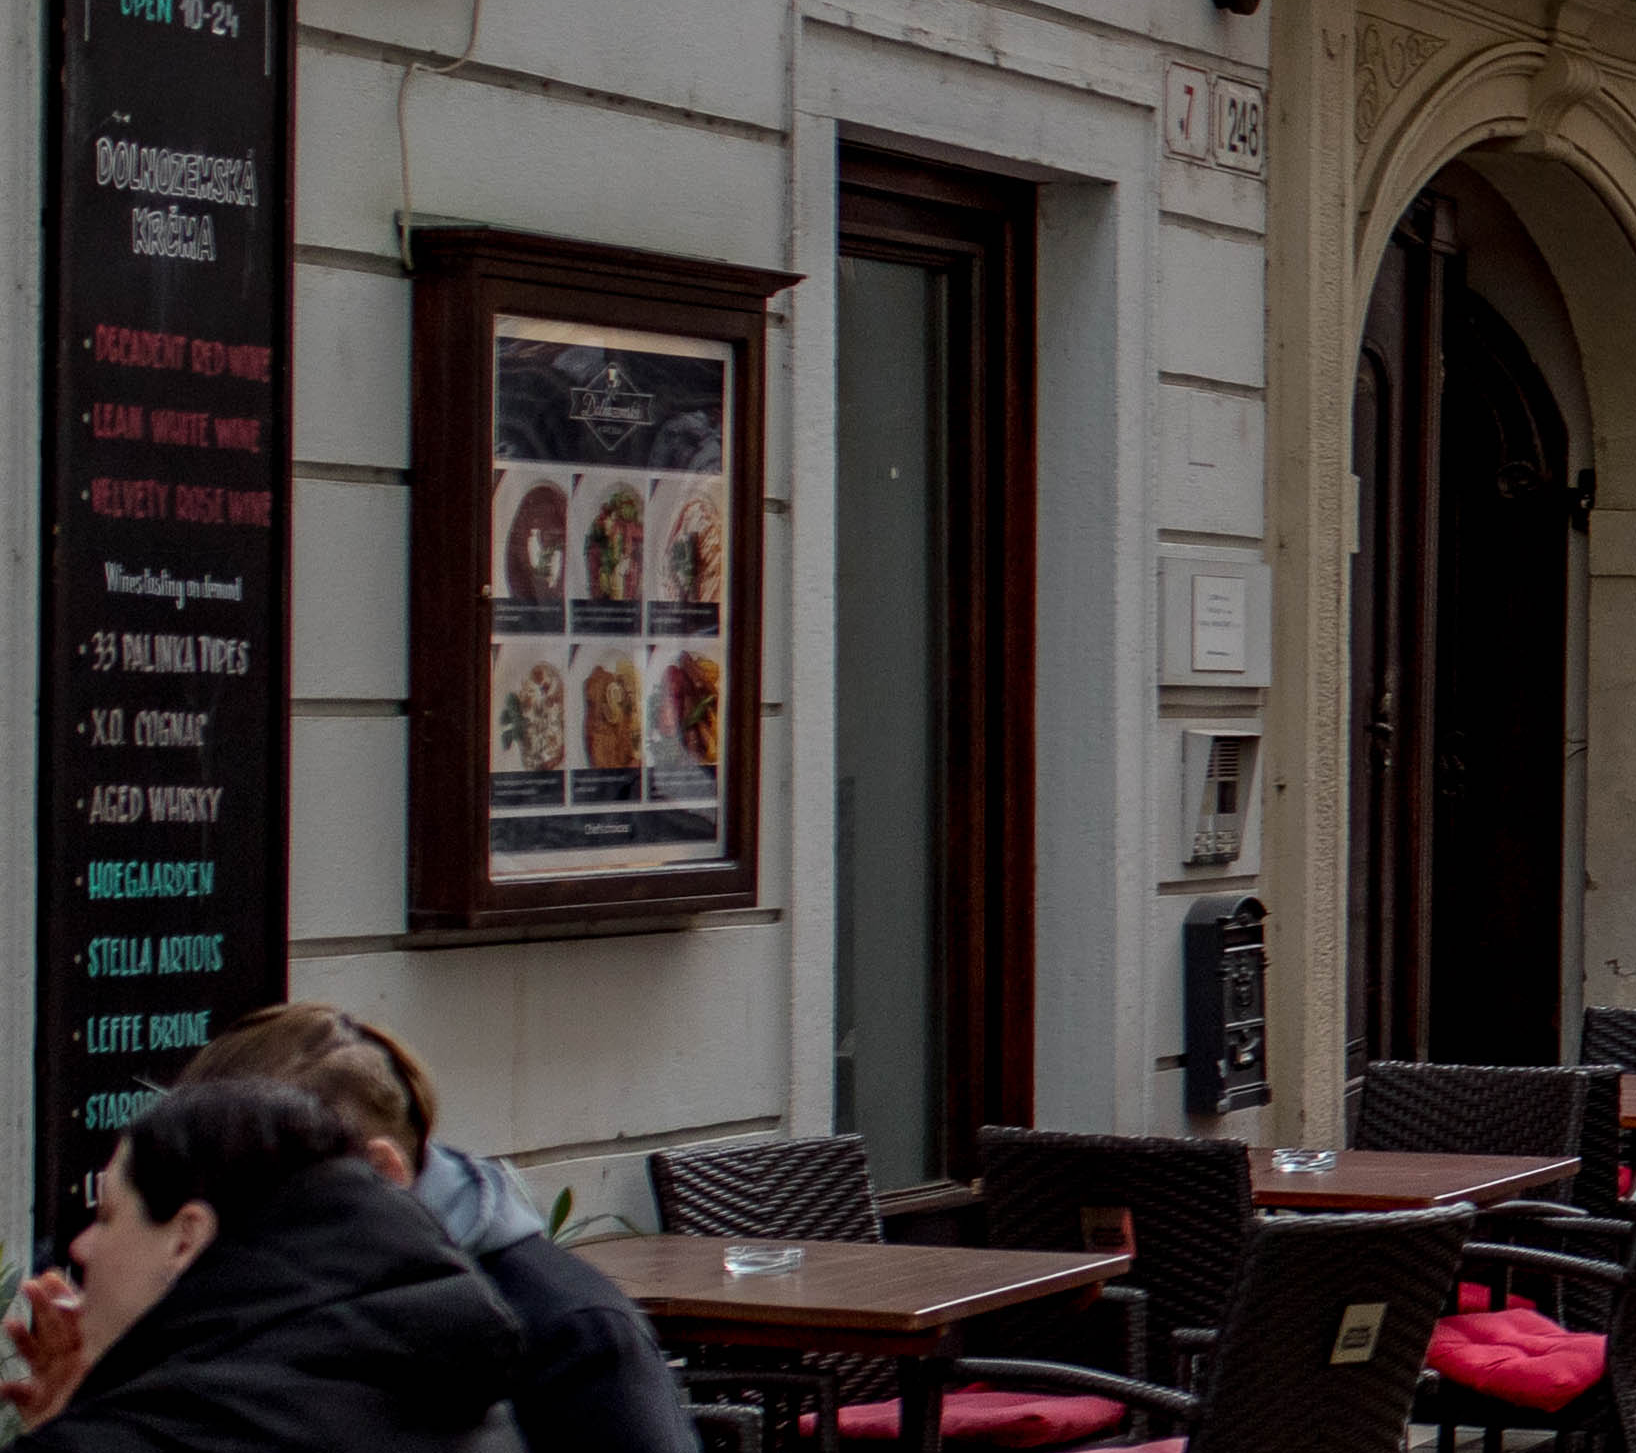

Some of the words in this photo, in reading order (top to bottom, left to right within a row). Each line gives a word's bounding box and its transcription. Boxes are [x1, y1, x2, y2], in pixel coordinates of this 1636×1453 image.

[92, 631, 117, 671] 33
[197, 635, 249, 675] TYPES
[89, 784, 144, 824] AGED
[148, 785, 224, 824] WHISKY
[88, 860, 215, 900] HOEGAARDEN
[88, 935, 152, 978] STELLA
[158, 932, 223, 975] ARTOIS
[86, 1014, 144, 1054] LEFFE
[150, 1009, 212, 1050] BRUNE
